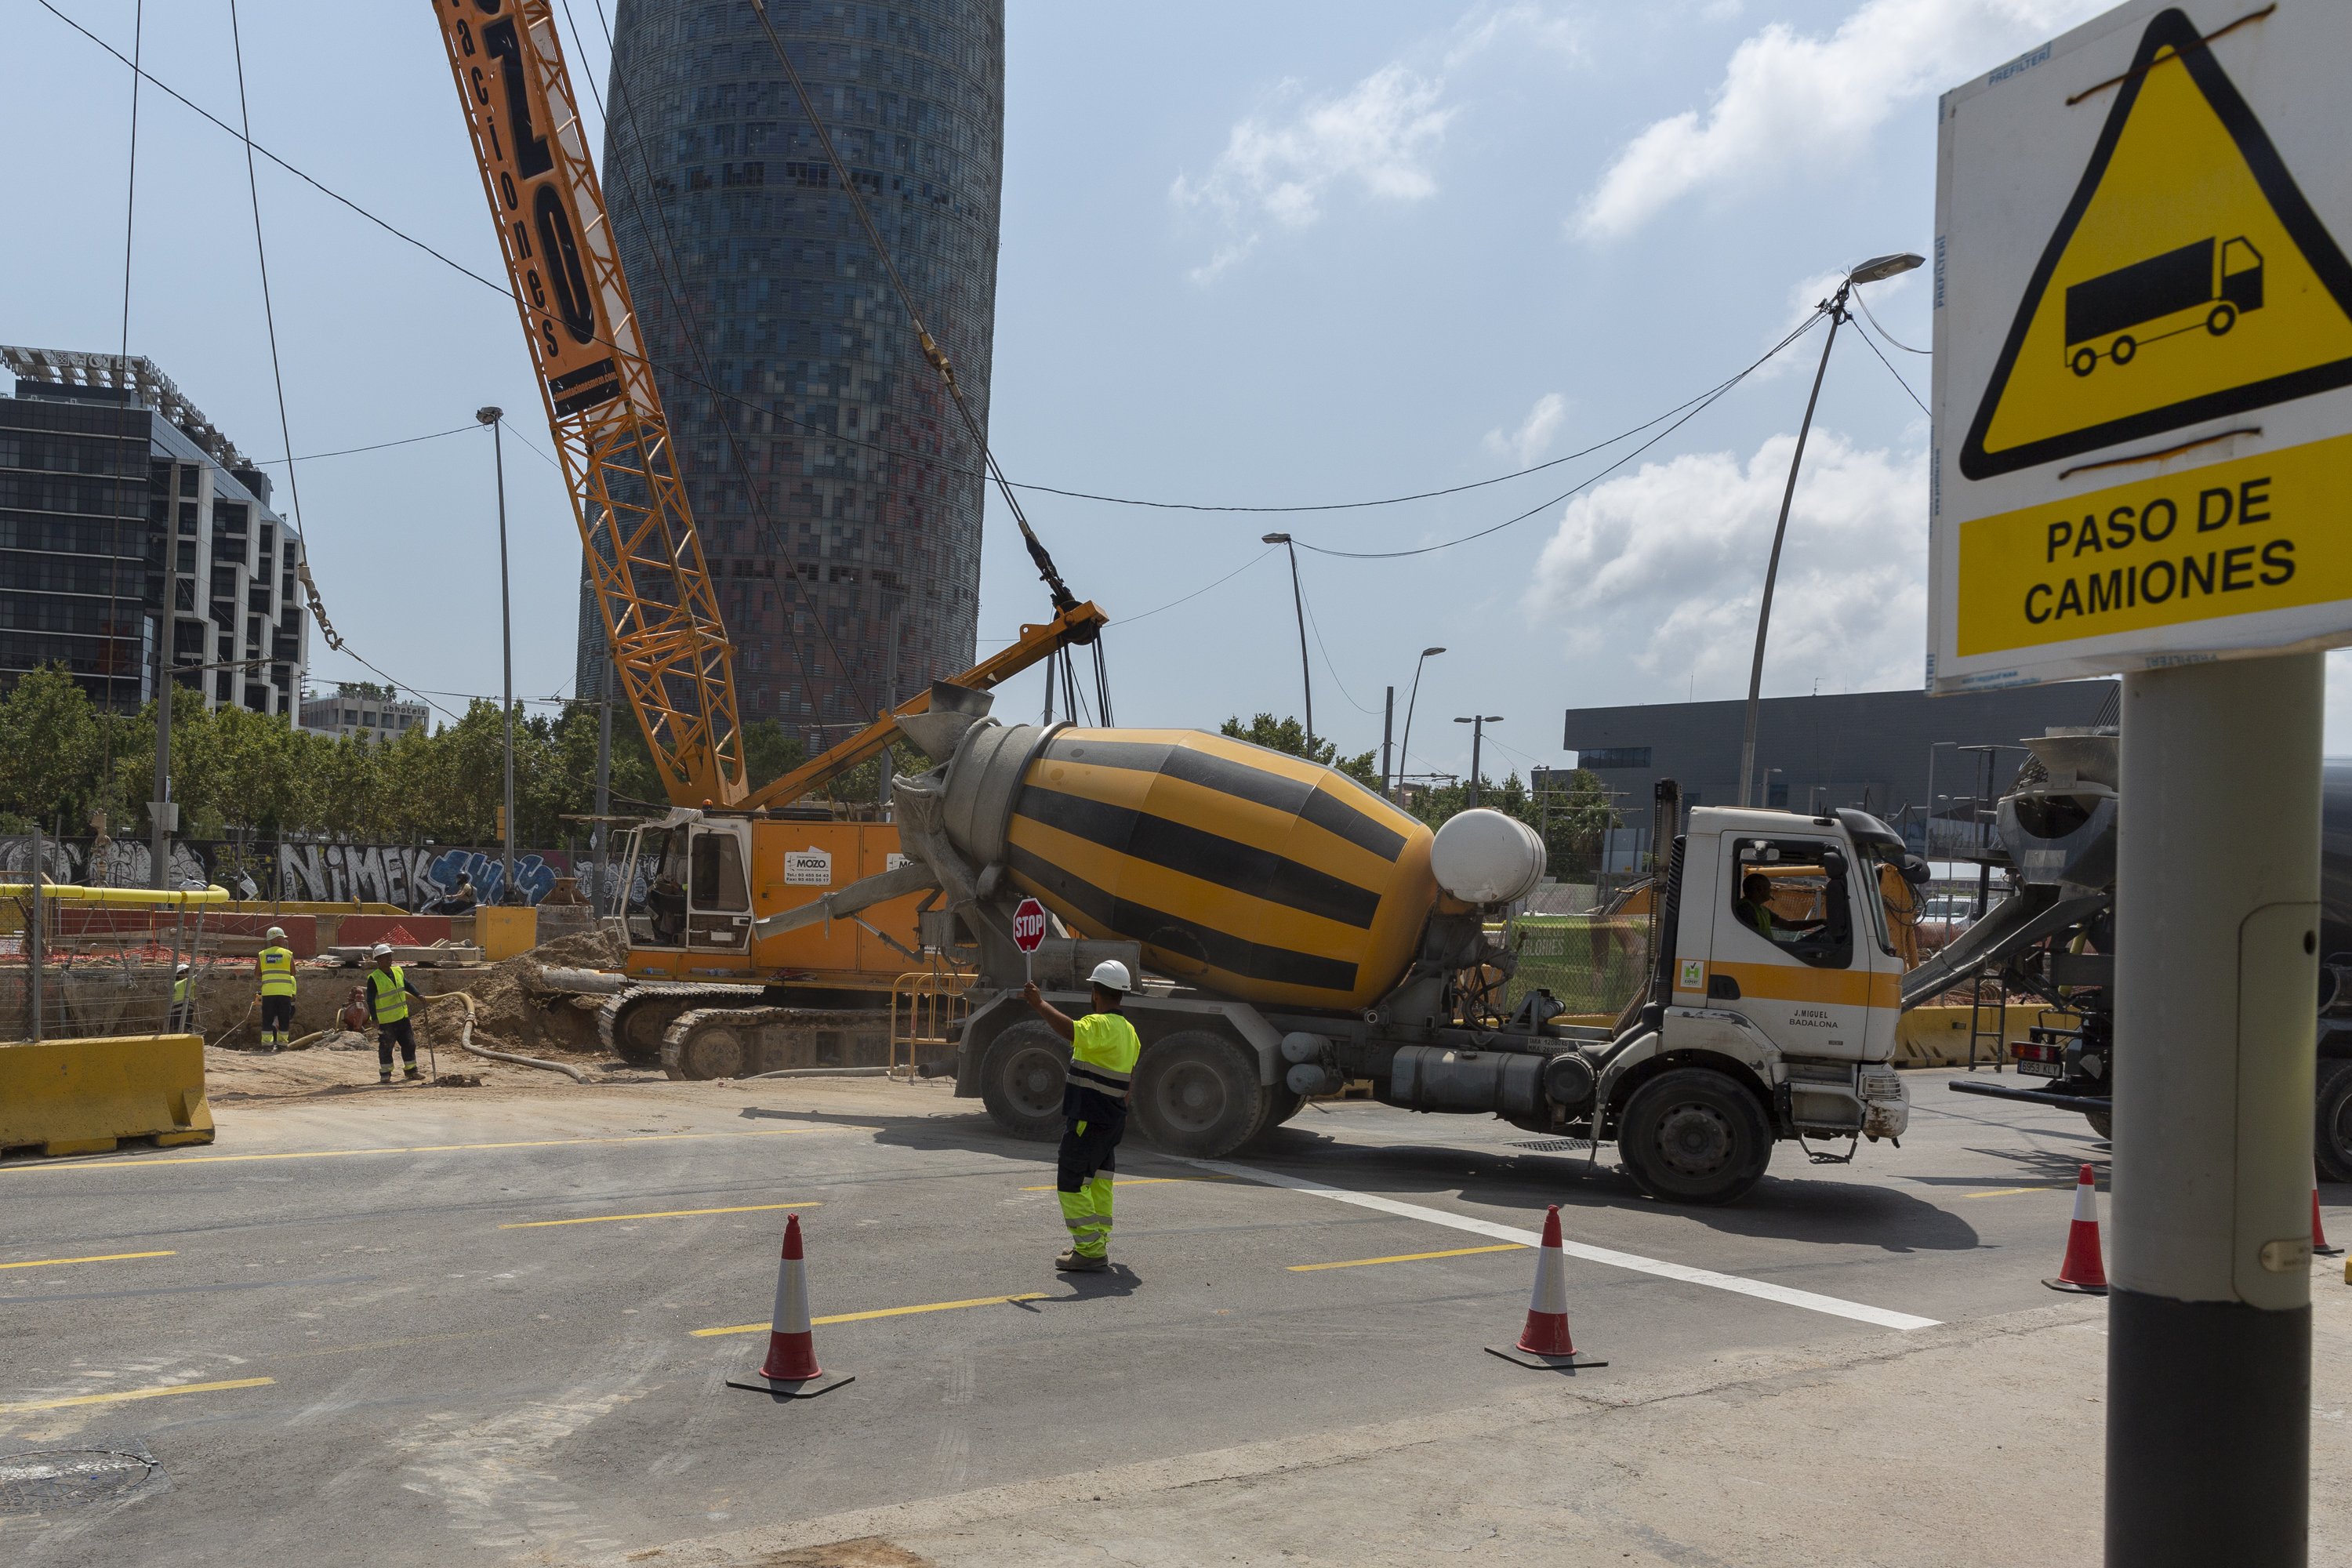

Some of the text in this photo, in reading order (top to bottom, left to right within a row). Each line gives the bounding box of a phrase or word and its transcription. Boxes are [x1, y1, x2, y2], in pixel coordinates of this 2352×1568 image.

[452, 0, 559, 358] aciones
[76, 351, 138, 372] HOTEL
[2047, 477, 2271, 563] PASO DE
[2024, 539, 2296, 624] CAMIONES
[383, 705, 426, 716] sbhotels
[797, 859, 826, 868] MOZO
[1015, 914, 1043, 938] STOP
[1789, 1018, 1838, 1029] BADALONA
[2022, 1062, 2058, 1075] 6953 KLY
